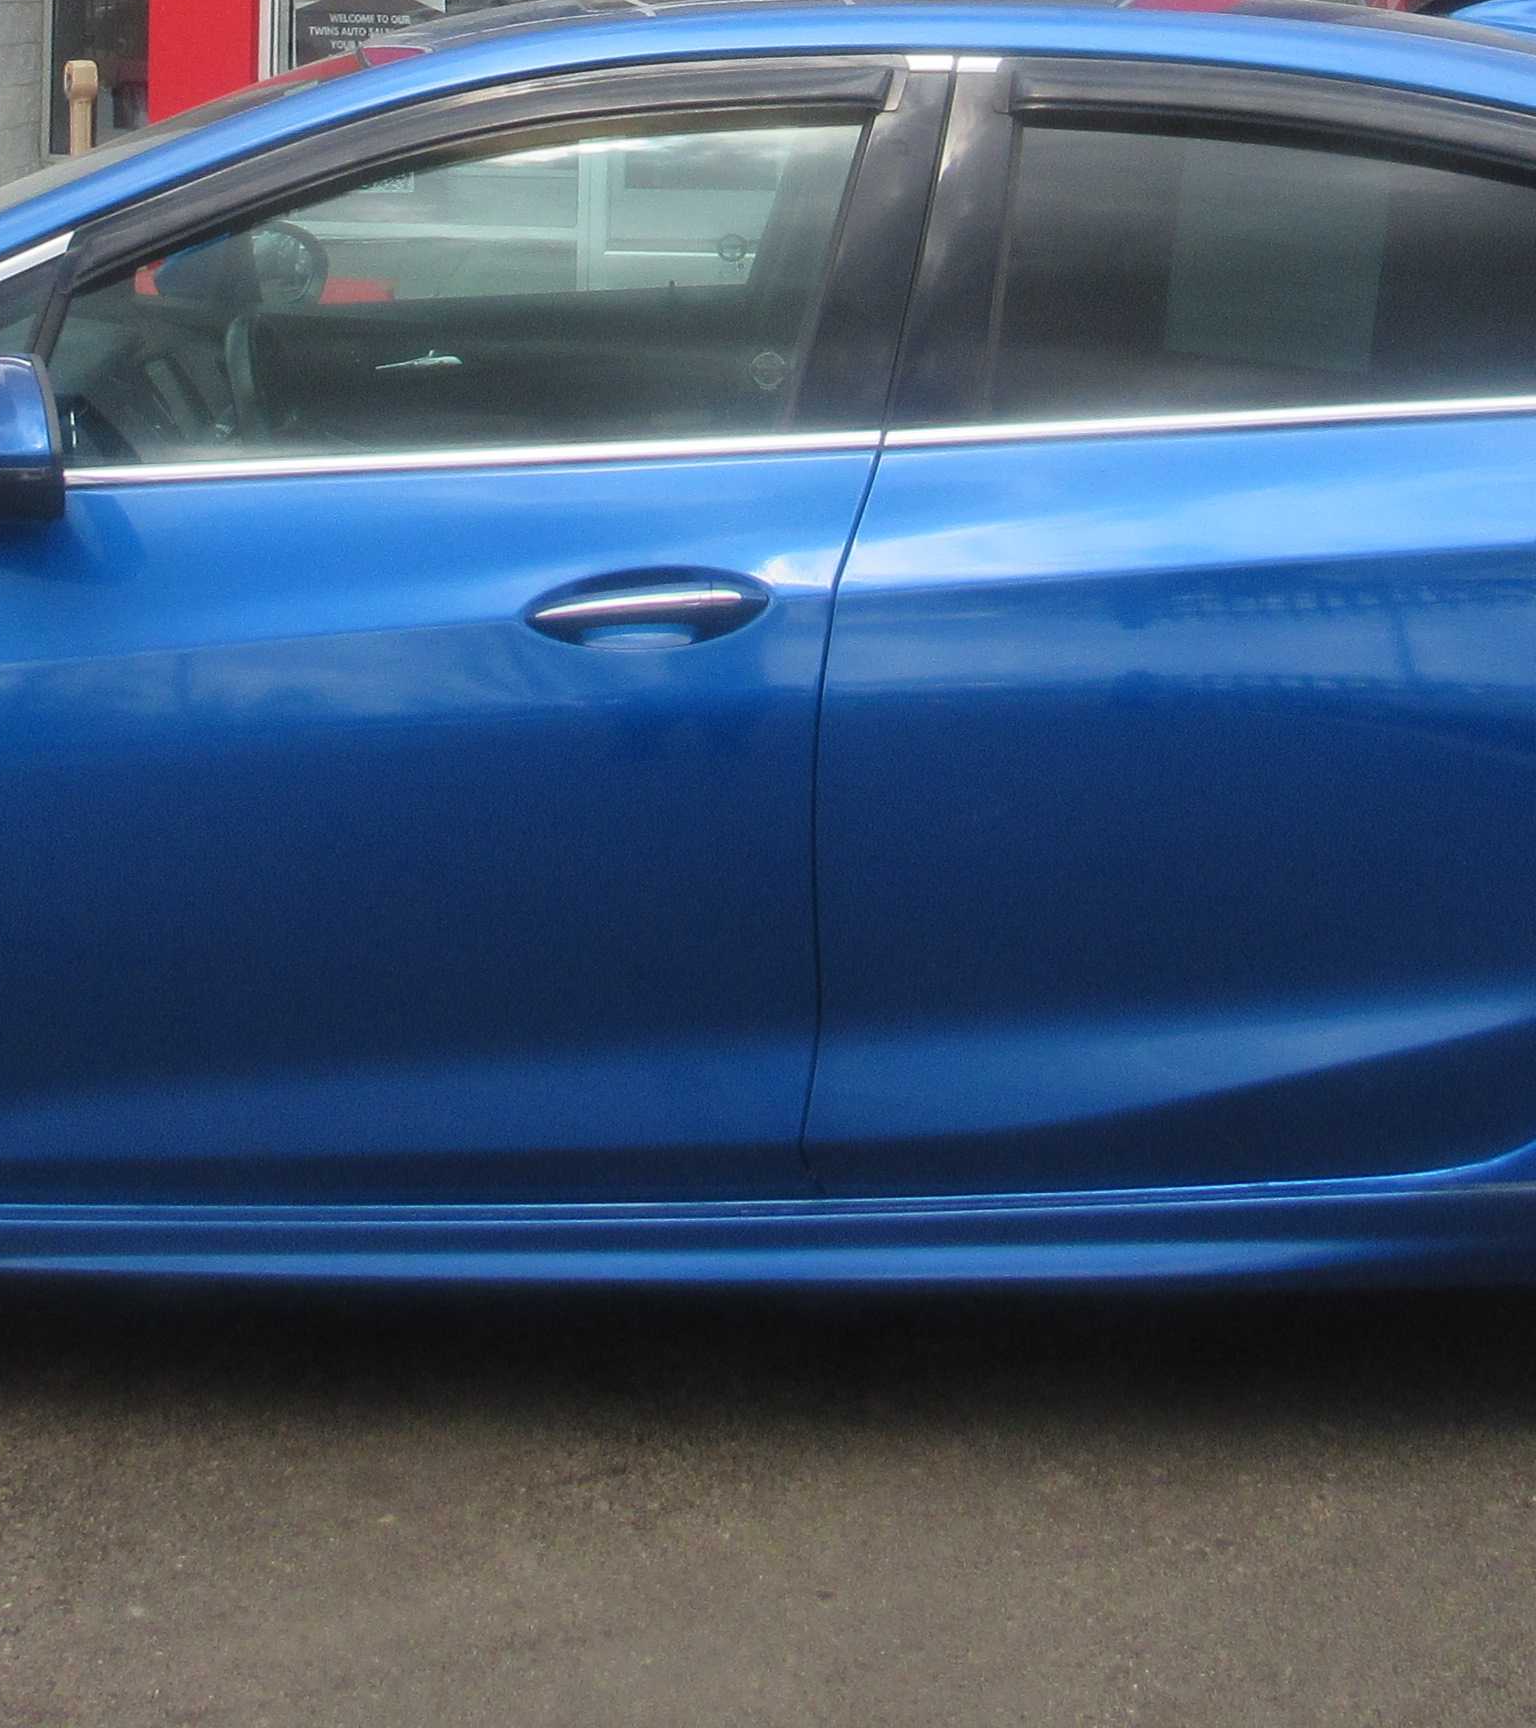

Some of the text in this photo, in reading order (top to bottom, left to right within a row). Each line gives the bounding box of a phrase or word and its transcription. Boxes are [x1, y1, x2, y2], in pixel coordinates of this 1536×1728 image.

[328, 14, 411, 25] WELCOME TO OUR
[309, 26, 339, 36] TWINS
[341, 27, 367, 37] AUTO
